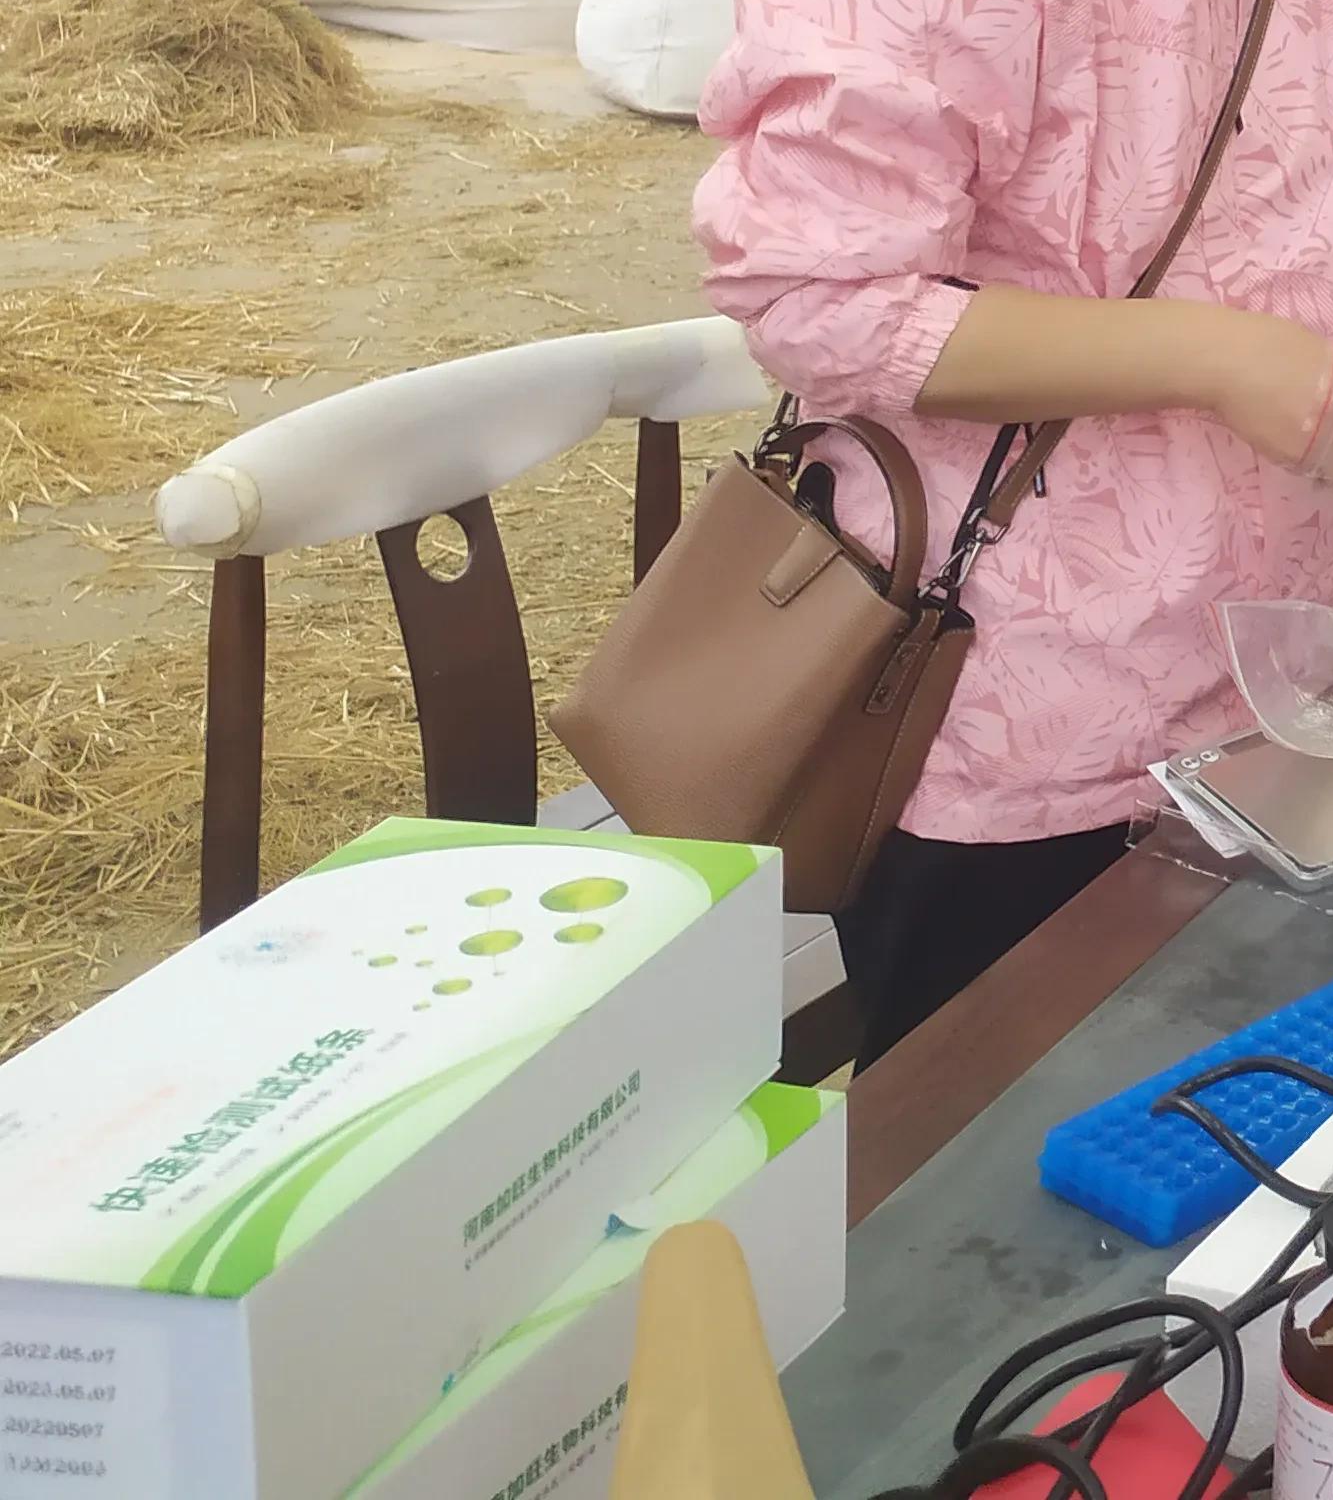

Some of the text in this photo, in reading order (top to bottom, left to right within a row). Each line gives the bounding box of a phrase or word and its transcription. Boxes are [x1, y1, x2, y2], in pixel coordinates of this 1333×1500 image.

[89, 1029, 374, 1211] 快速检测试纸条
